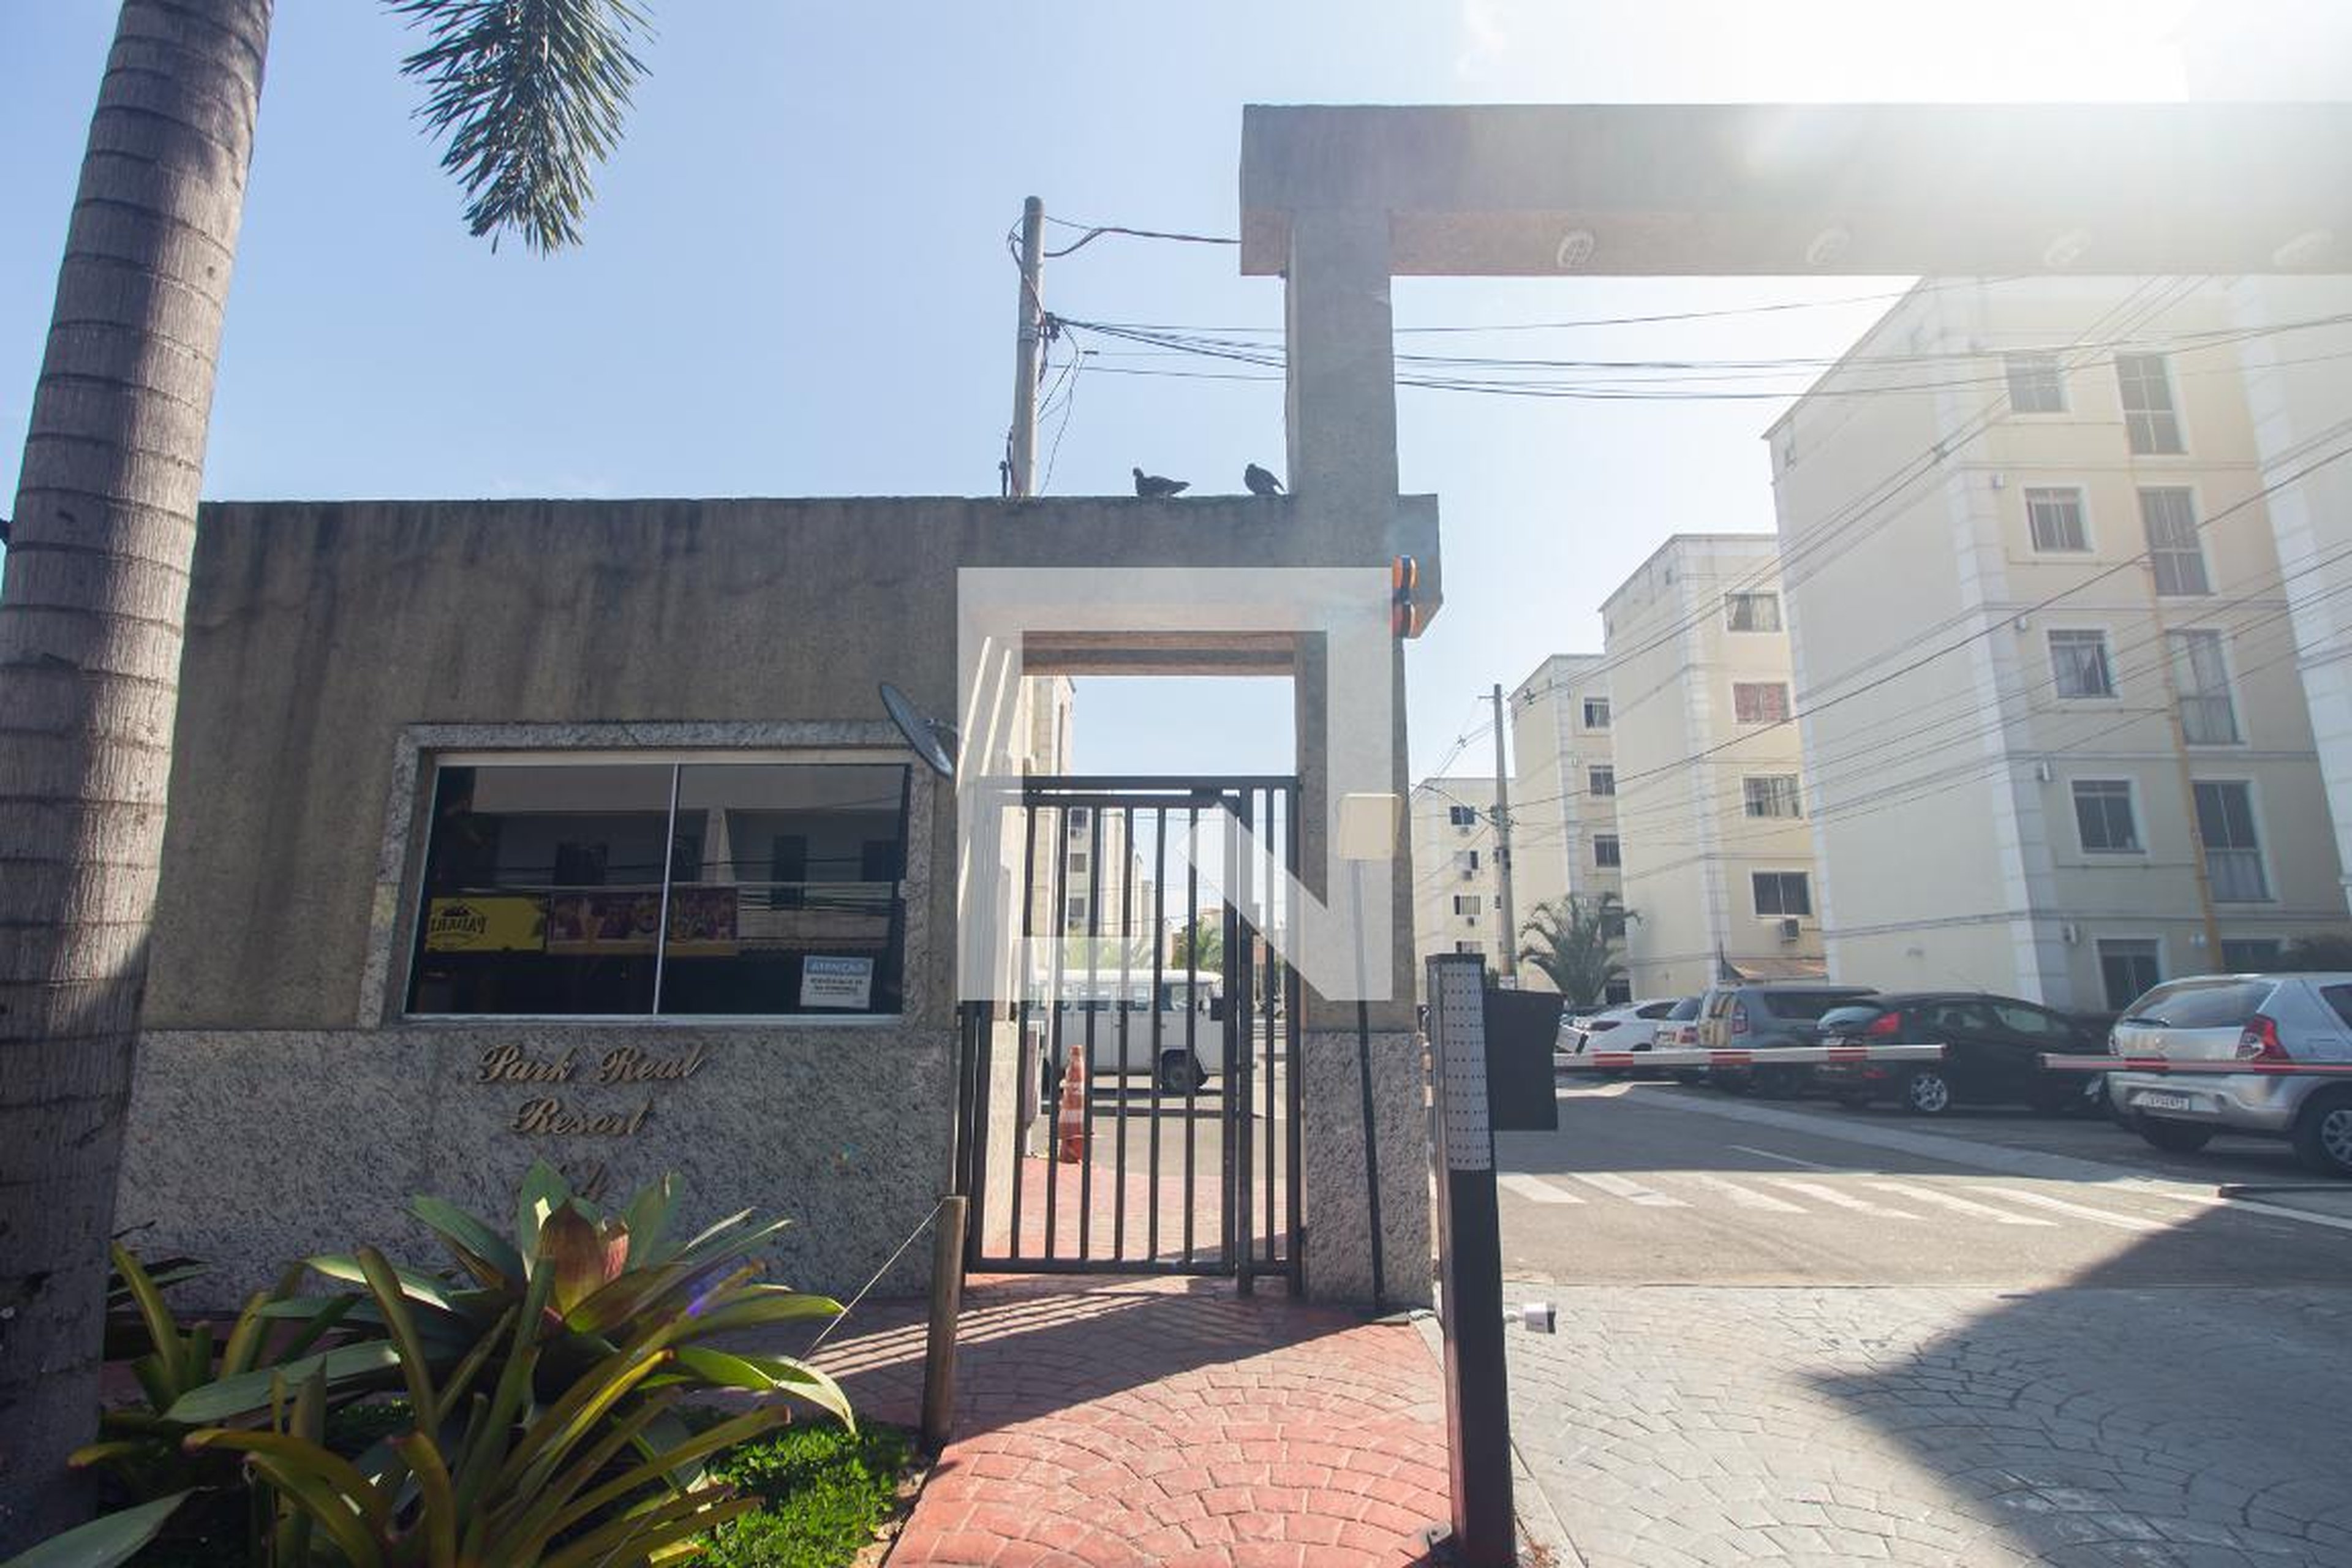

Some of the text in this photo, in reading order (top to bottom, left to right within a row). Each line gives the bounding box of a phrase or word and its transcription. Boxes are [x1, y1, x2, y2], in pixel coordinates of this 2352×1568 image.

[479, 1044, 704, 1084] Park Real
[511, 1098, 654, 1136] Resort
